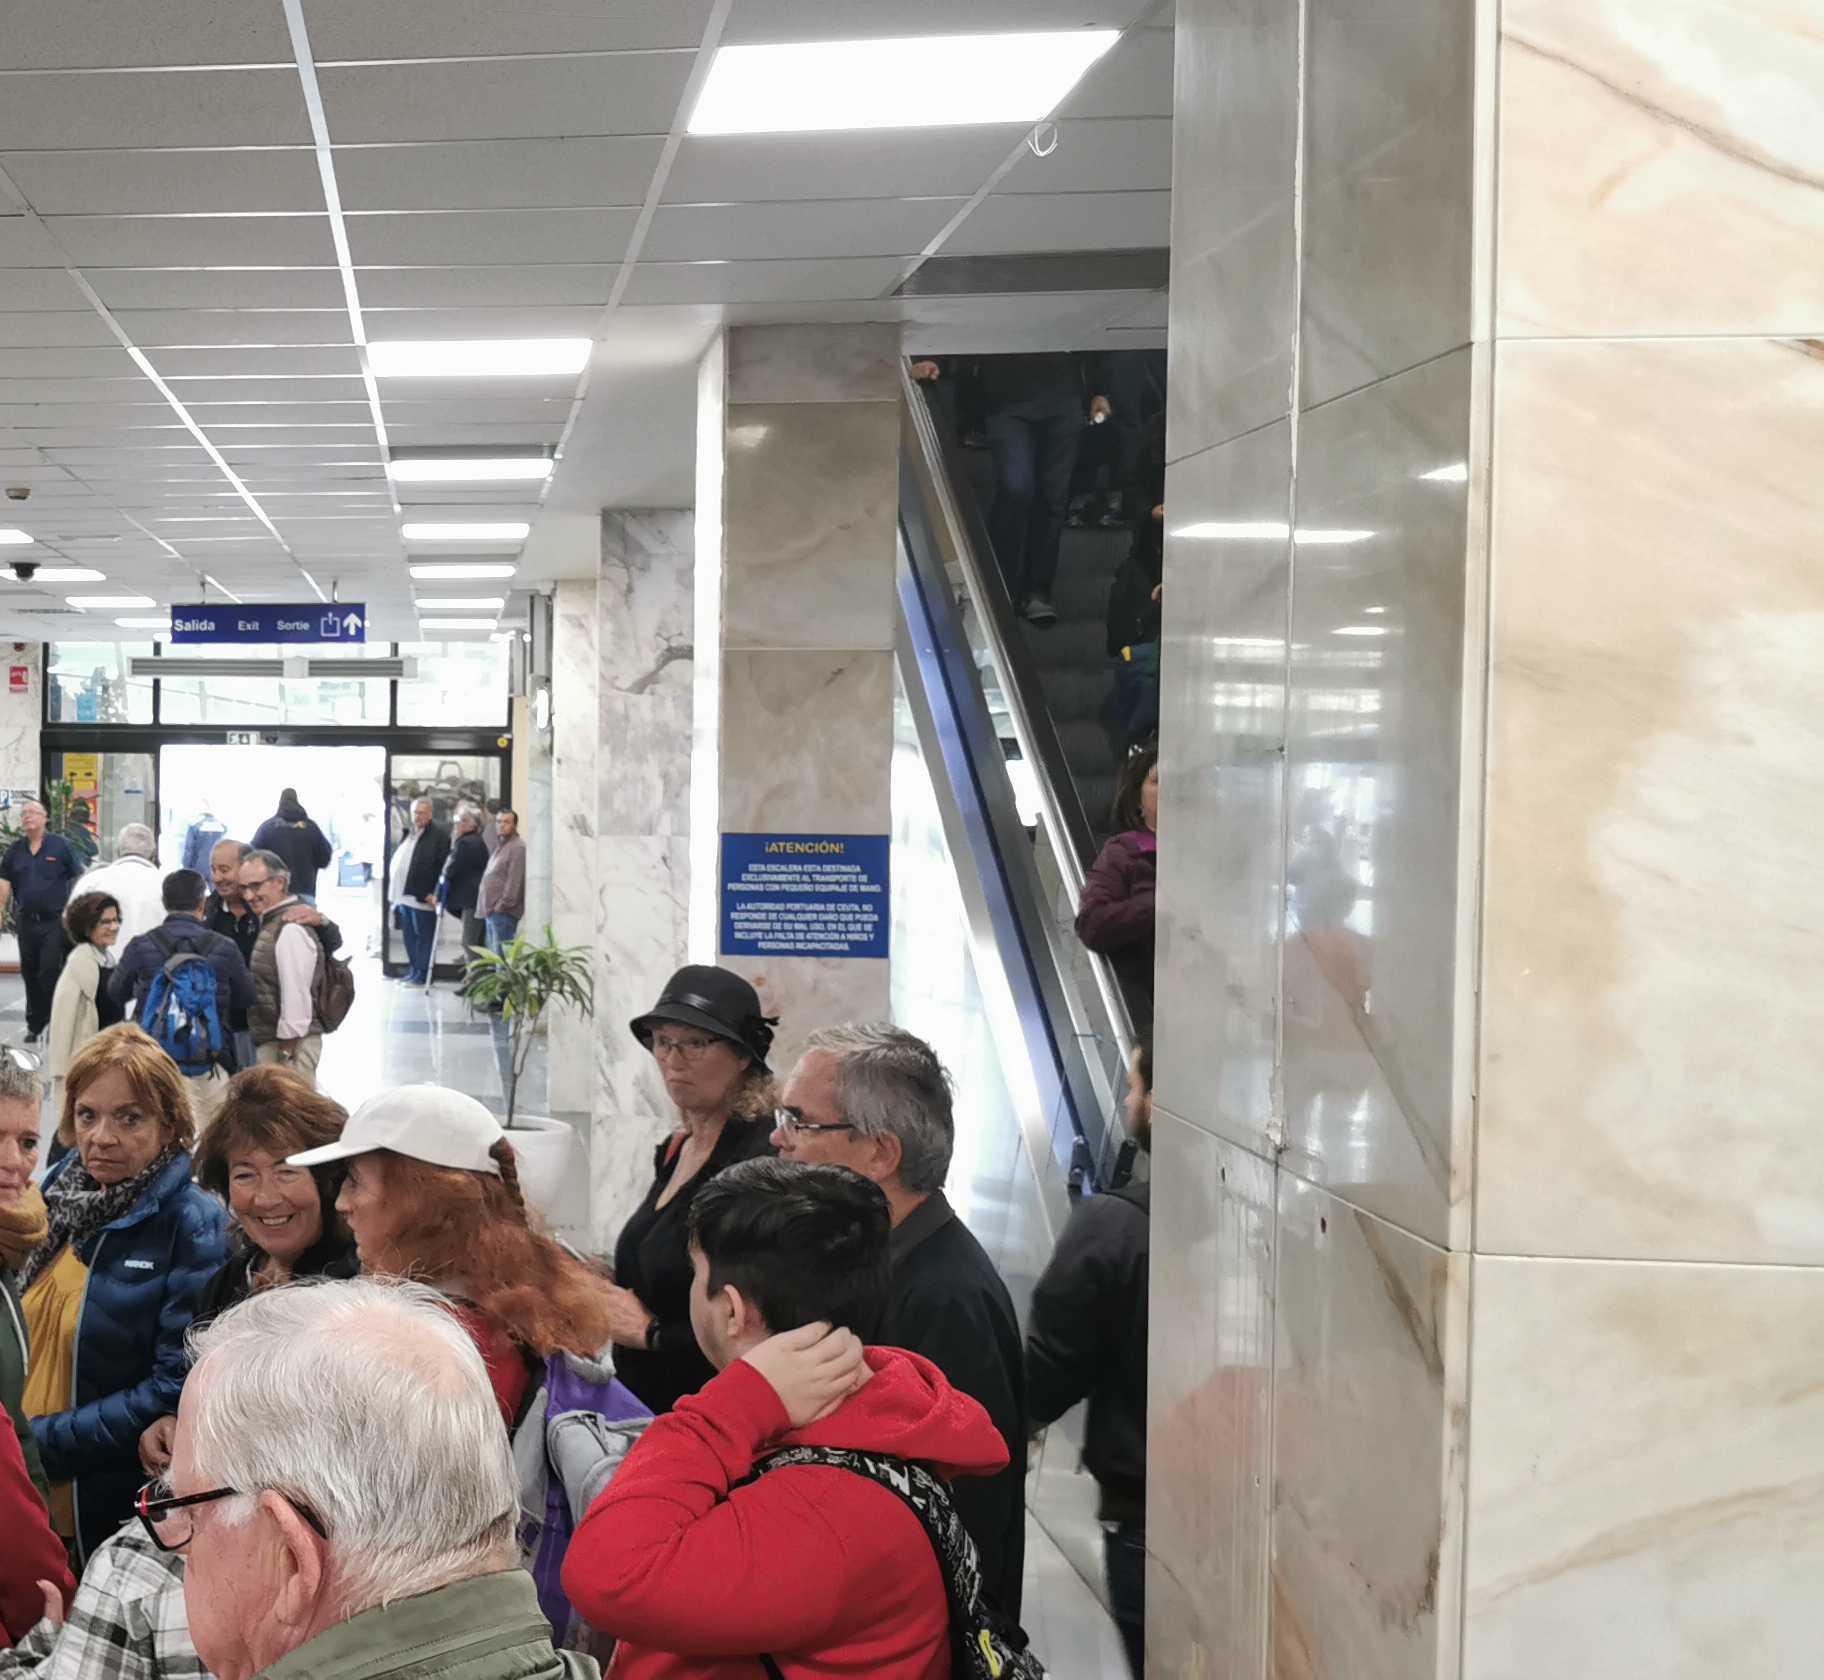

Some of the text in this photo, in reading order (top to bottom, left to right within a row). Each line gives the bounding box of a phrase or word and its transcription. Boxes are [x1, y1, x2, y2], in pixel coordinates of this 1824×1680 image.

[174, 619, 310, 632] Salida Exit Sortie
[765, 841, 845, 854] ¡ATENCIÓN!
